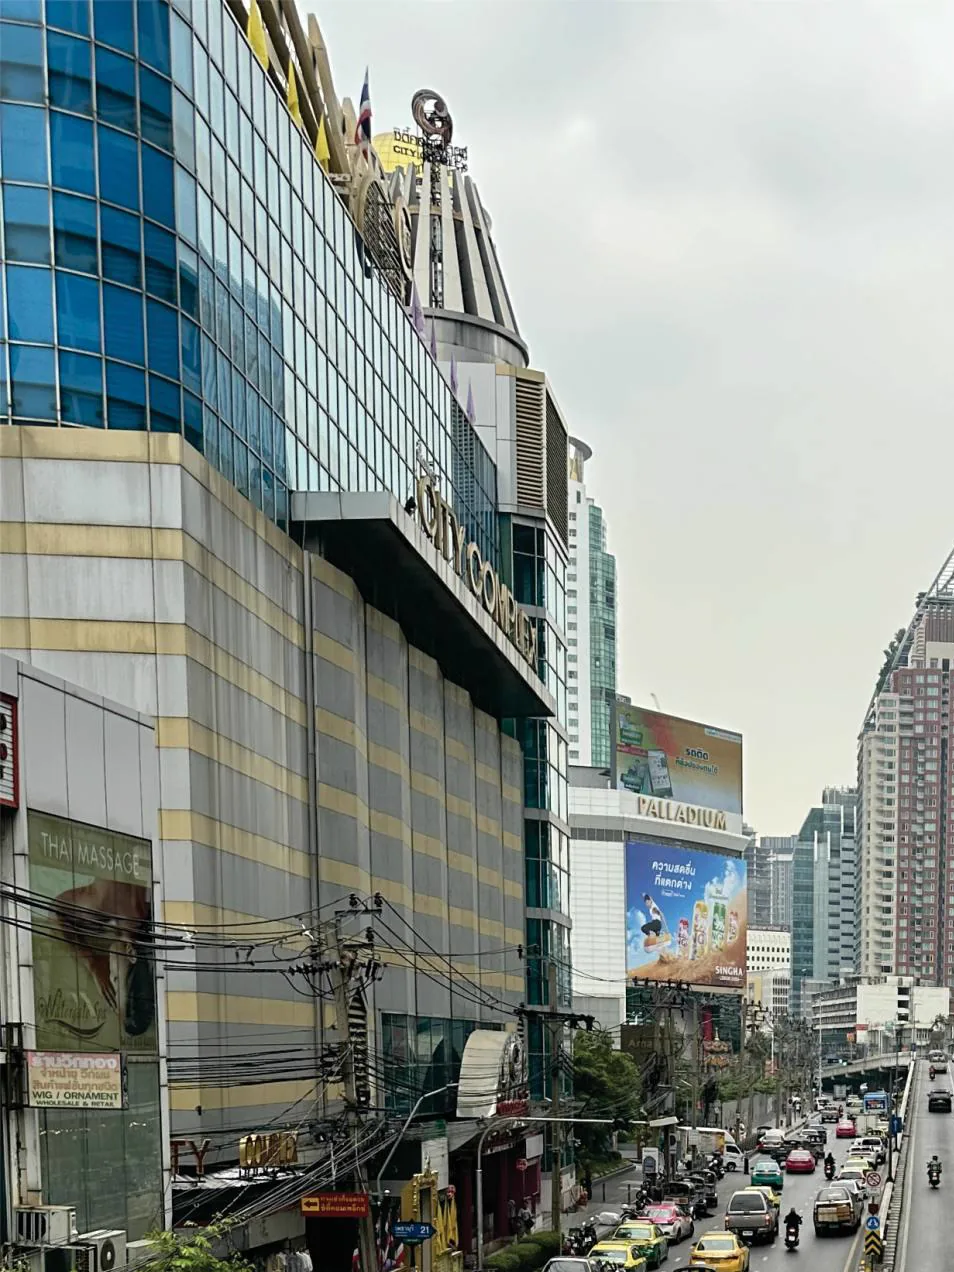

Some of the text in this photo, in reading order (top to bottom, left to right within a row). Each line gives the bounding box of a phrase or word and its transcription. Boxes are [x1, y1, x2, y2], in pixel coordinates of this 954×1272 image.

[393, 145, 417, 158] CITY
[417, 475, 466, 577] CITY
[466, 541, 538, 674] COMPLEX
[638, 796, 727, 831] PALLADIUM
[41, 831, 141, 879] THAI MASSAGE
[651, 860, 696, 876] ความสดชื่น
[715, 965, 744, 976] SINGHA
[32, 1090, 53, 1099] WIG
[63, 1091, 119, 1100] ORNAMENT
[420, 1225, 430, 1234] 21
